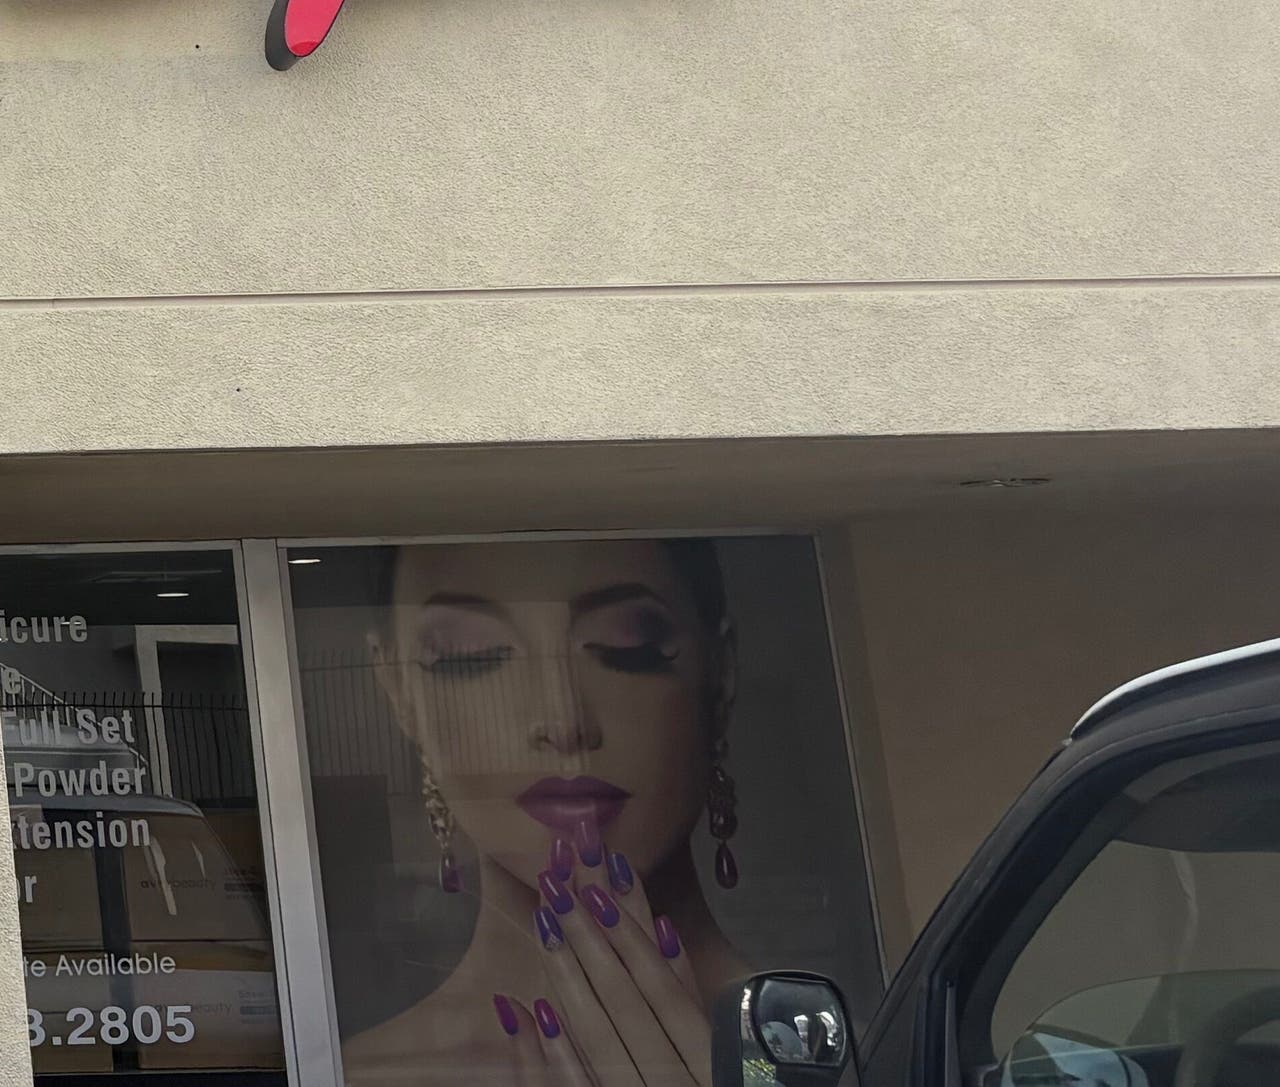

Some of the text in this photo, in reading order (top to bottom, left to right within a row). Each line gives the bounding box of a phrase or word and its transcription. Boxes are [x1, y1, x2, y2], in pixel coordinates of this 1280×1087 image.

[76, 709, 135, 744] Set
[13, 757, 147, 798] Powder
[55, 953, 177, 976] Available
